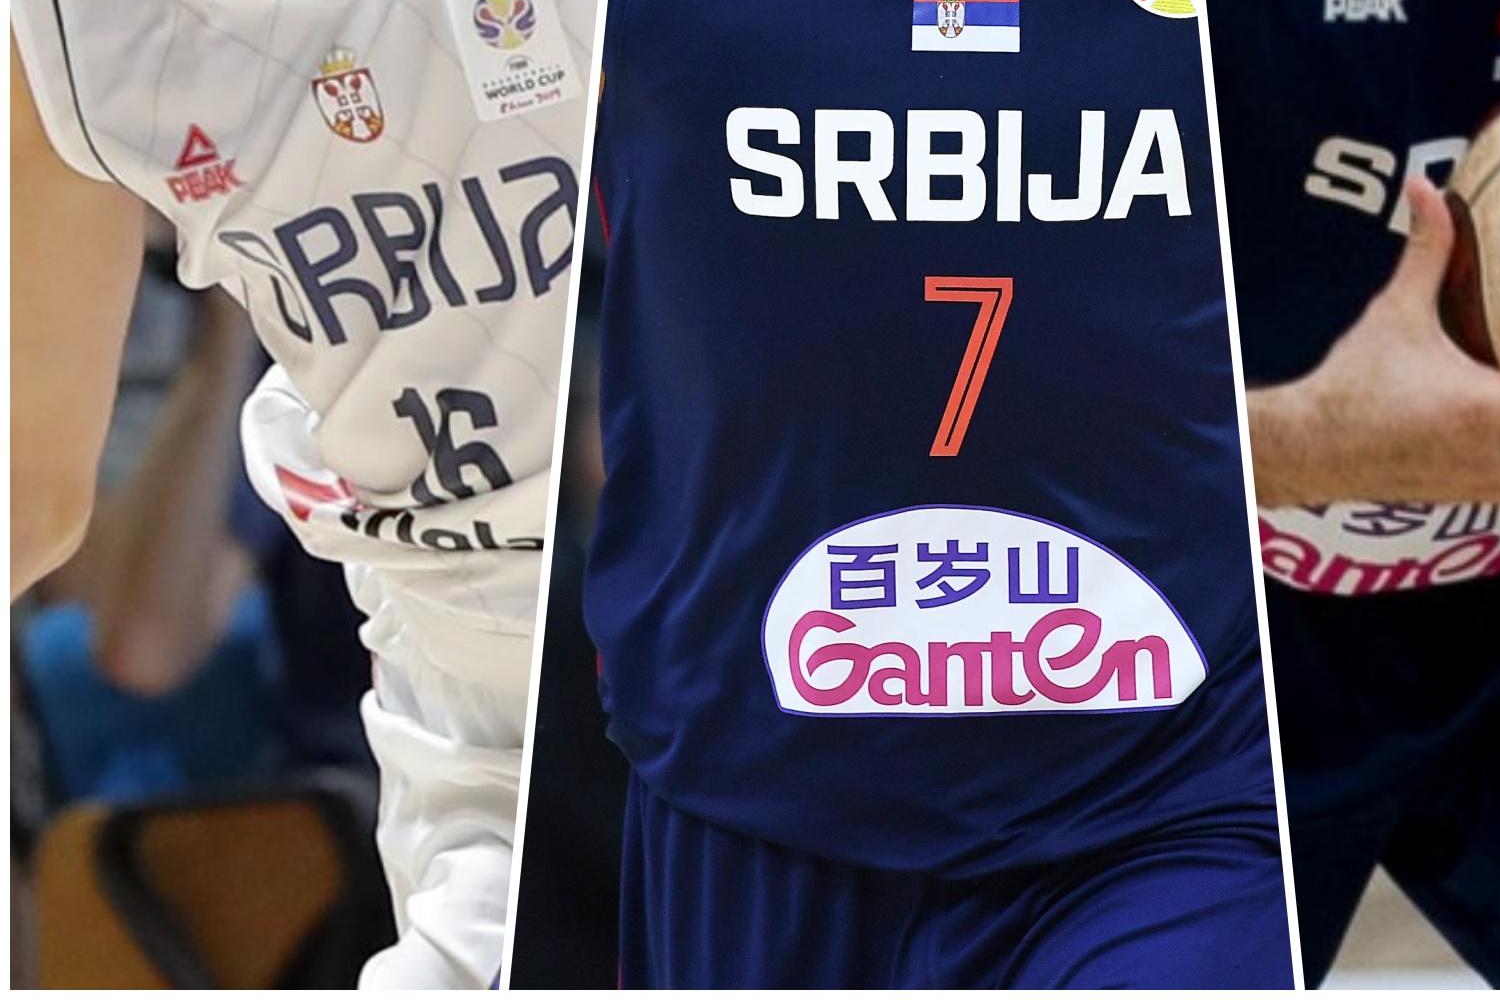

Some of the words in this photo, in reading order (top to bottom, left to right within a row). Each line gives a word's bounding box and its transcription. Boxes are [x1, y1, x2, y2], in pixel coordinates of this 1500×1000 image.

[485, 80, 534, 100] WORLD
[538, 70, 565, 86] CUP
[165, 158, 241, 203] PEAK
[725, 107, 1192, 222] SRBIJA
[923, 276, 1014, 458] 7
[393, 387, 513, 508] 16
[826, 539, 1081, 610] 百岁山
[788, 608, 1175, 709] Ganten
